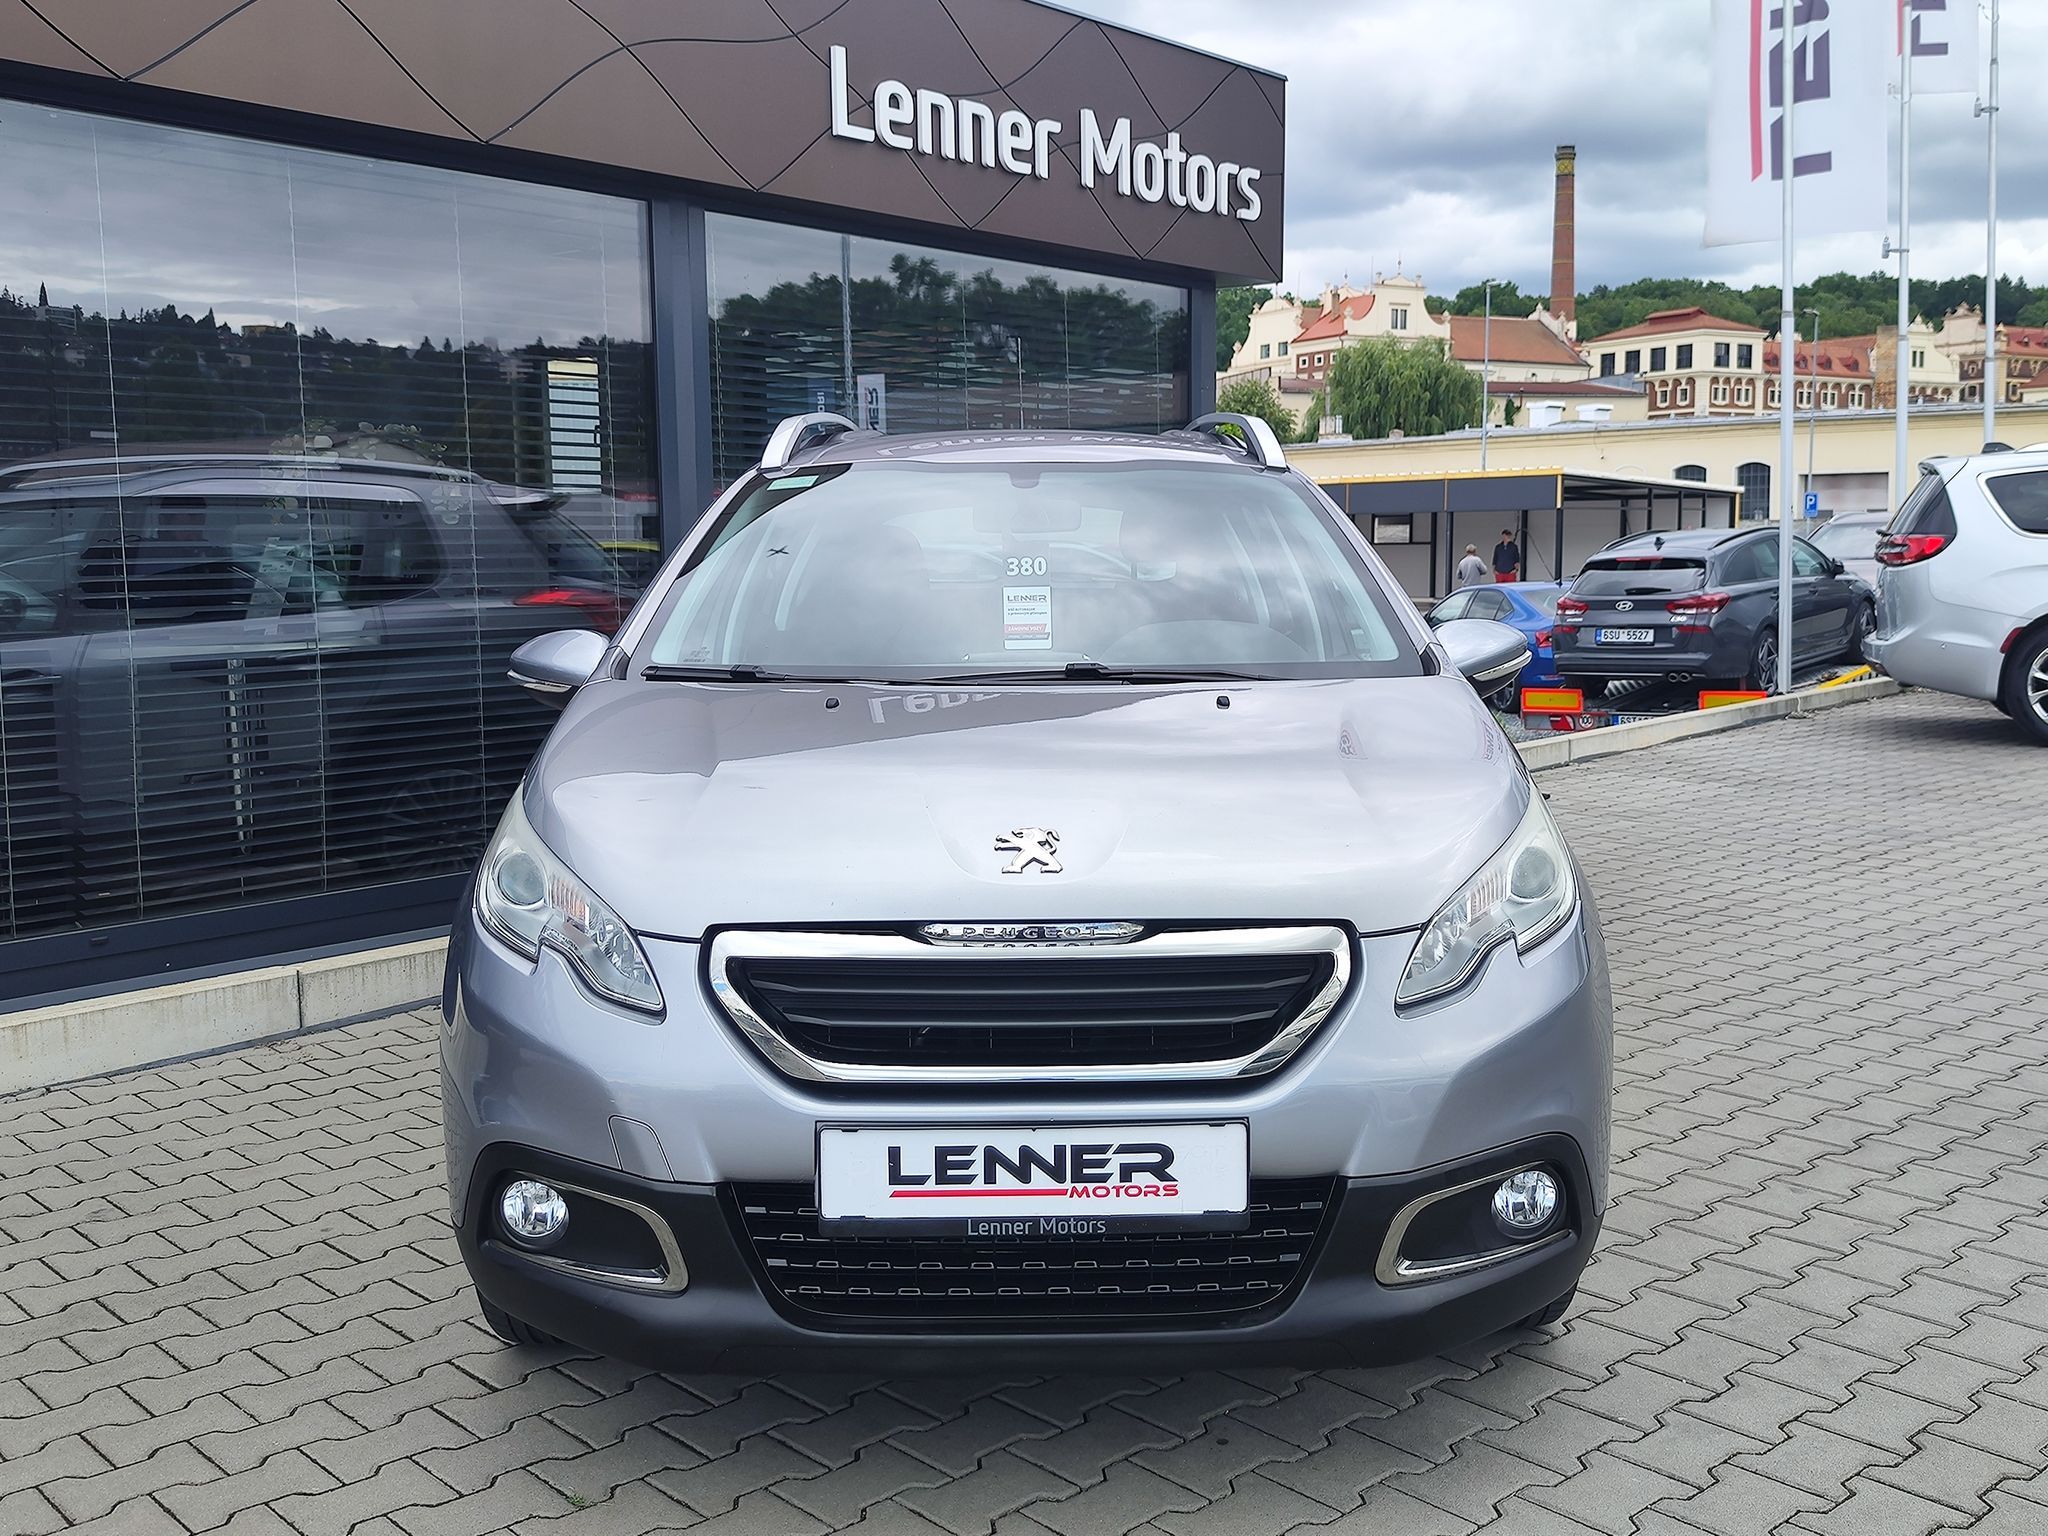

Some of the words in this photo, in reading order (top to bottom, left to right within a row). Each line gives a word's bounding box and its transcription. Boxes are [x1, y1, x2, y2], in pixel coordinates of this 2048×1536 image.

[829, 44, 1063, 180] Lenner
[1079, 108, 1263, 222] Motors
[1806, 495, 1816, 510] P
[1006, 556, 1047, 576] 380
[1007, 594, 1047, 603] LENNER
[1603, 630, 1620, 640] 6SU
[1627, 630, 1649, 640] 5527
[962, 926, 1099, 939] PEUGEOT
[887, 1142, 1179, 1186] LENNER
[1069, 1183, 1179, 1199] MOTORS
[967, 1218, 1031, 1237] Lenner
[1039, 1217, 1107, 1235] Motors
